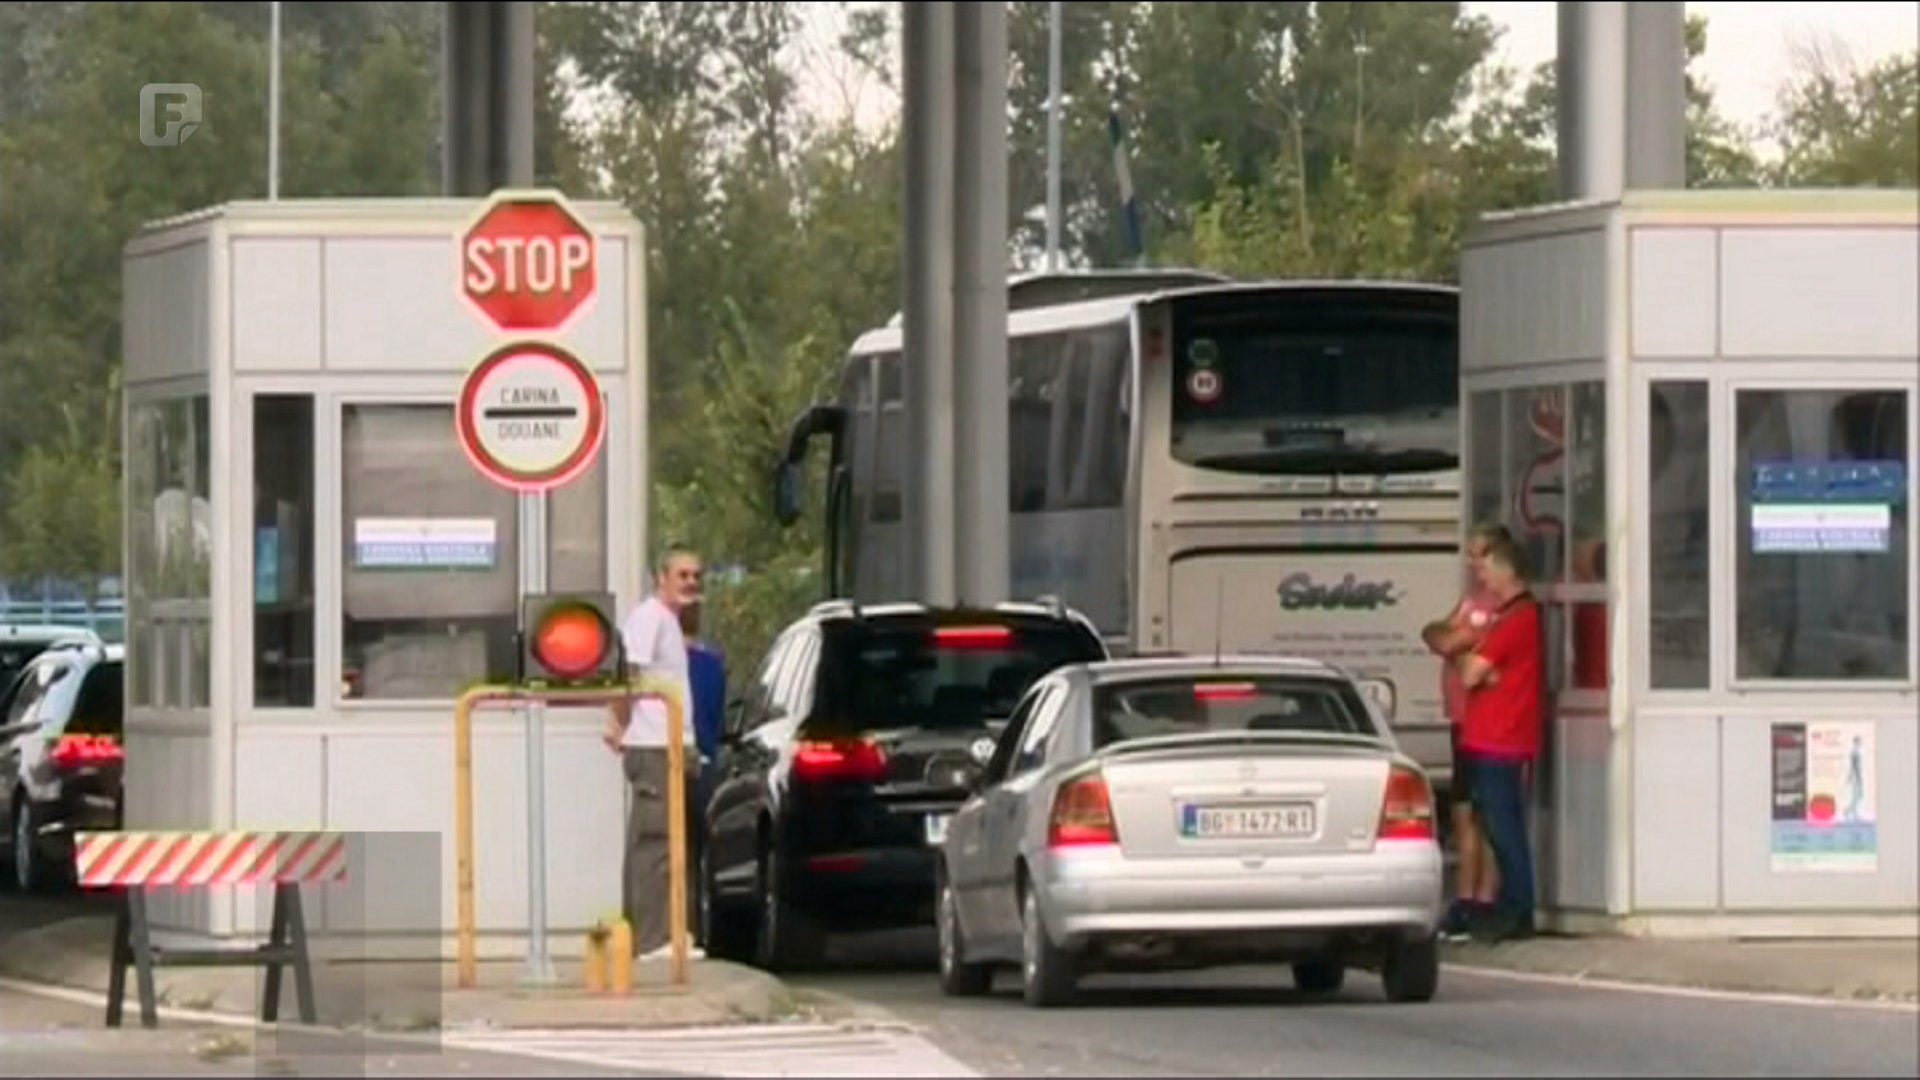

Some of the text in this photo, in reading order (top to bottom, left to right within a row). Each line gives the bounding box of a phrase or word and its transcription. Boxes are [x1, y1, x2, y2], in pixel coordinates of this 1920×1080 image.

[467, 236, 590, 292] STOP
[501, 388, 560, 404] CARINA
[498, 422, 562, 439] DOUANE
